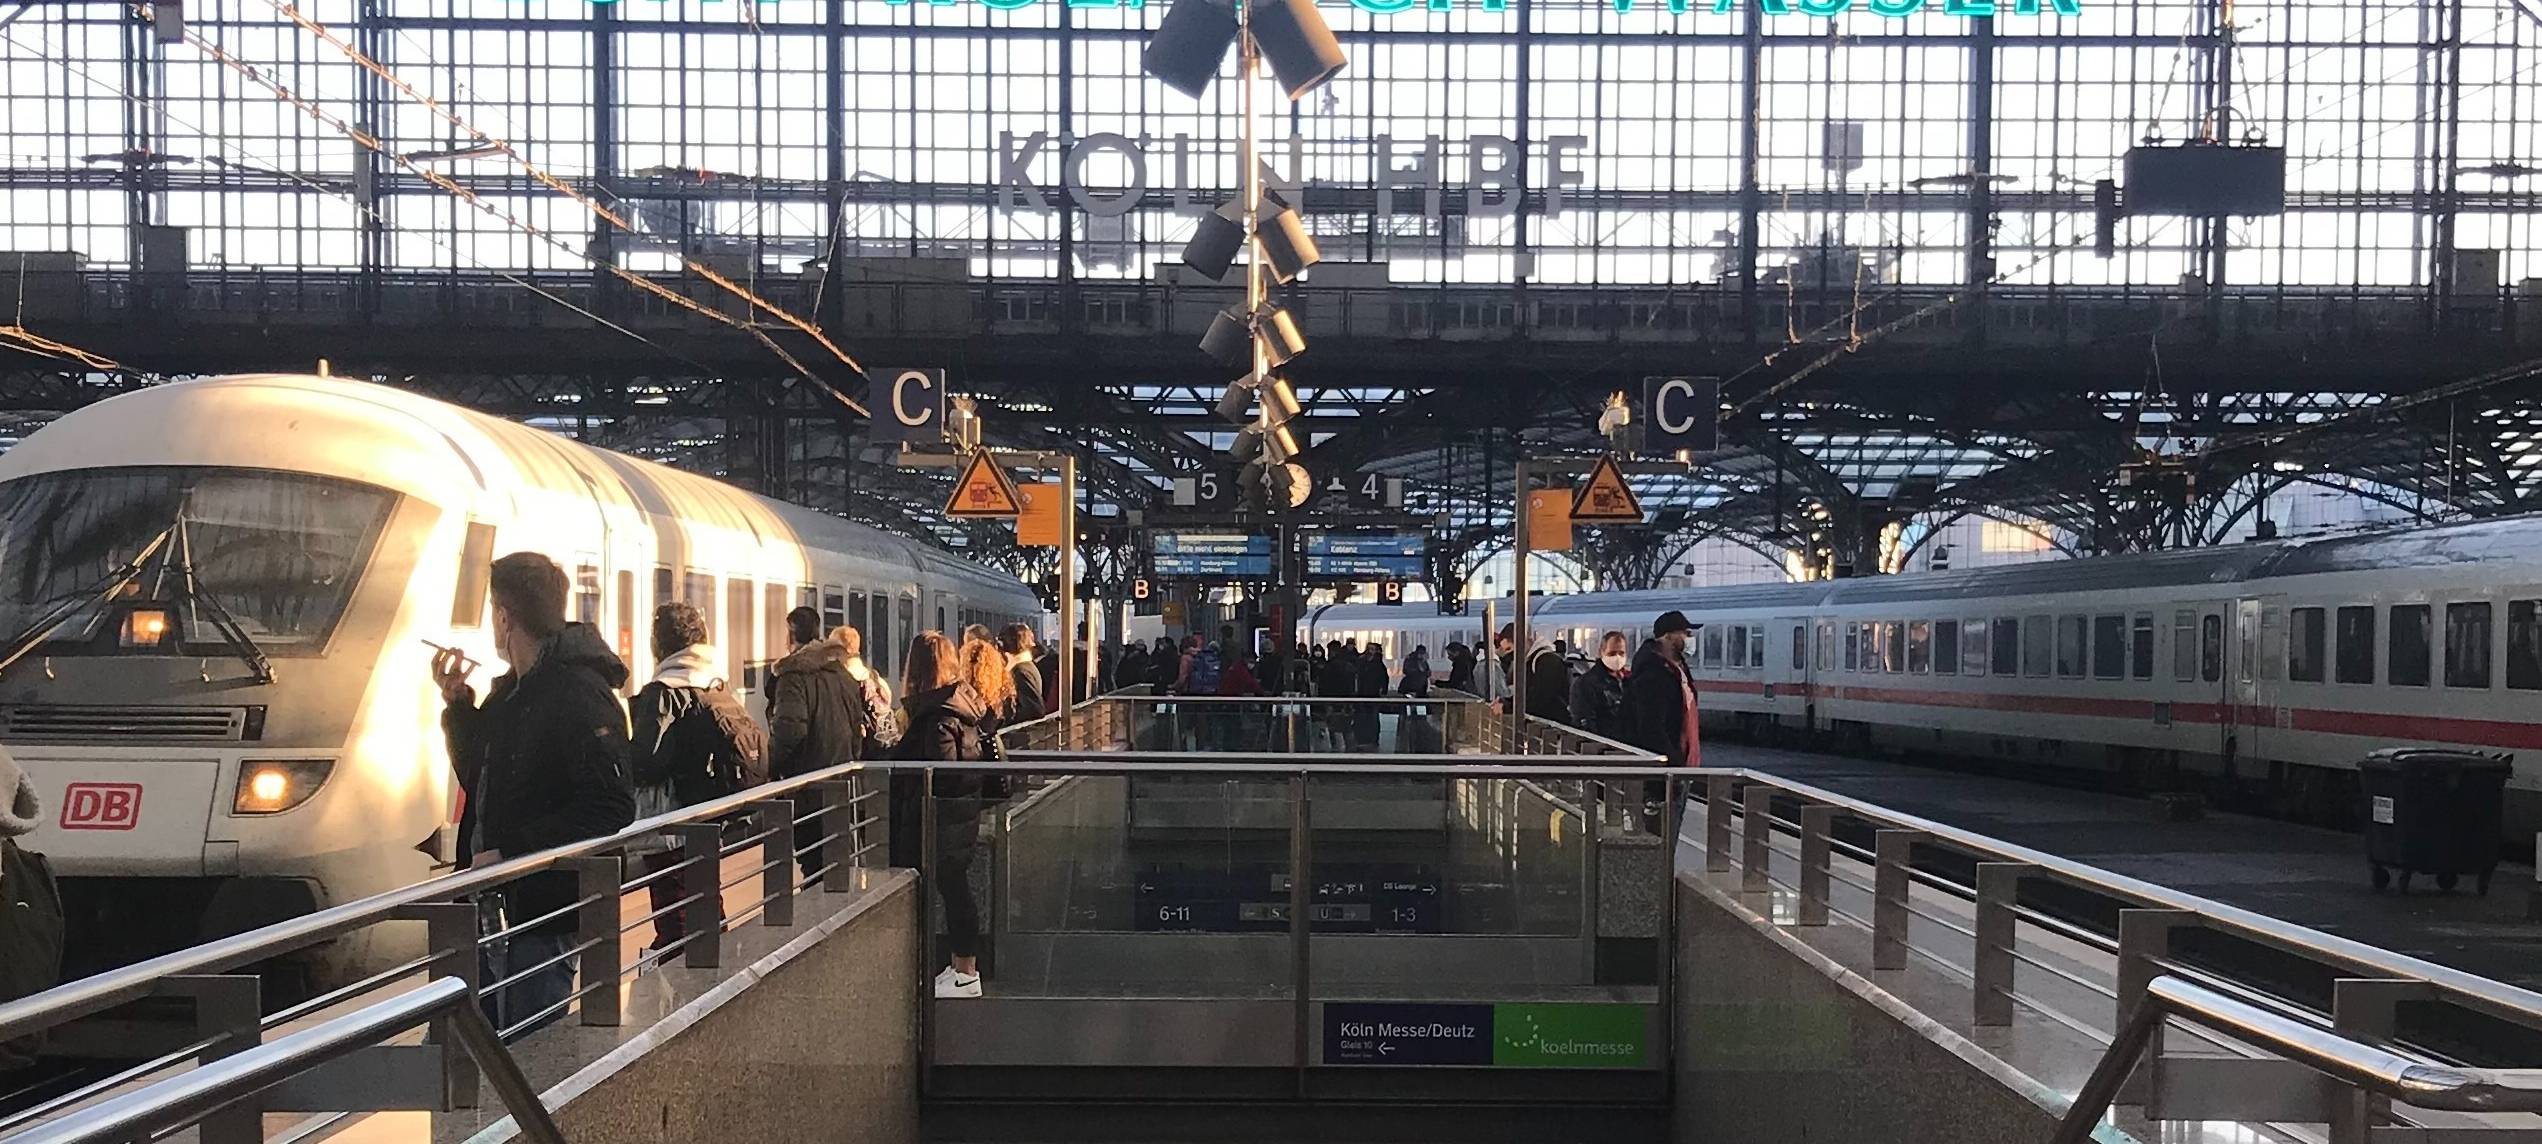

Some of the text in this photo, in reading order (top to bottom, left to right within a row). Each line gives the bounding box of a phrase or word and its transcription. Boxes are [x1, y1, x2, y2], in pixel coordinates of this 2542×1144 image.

[1000, 131, 1588, 219] KÖLN HBF
[892, 371, 932, 426] C
[1655, 379, 1695, 434] C
[1200, 473, 1218, 500] 5
[1361, 473, 1379, 500] 4
[1134, 580, 1149, 599] B
[1385, 582, 1400, 601] B
[70, 789, 131, 822] DB
[1159, 905, 1190, 921] 6-11
[1391, 906, 1416, 922] 1-3
[1340, 1022, 1476, 1038] Köln Messe/Deutz
[1540, 1038, 1635, 1055] koelnmesse
